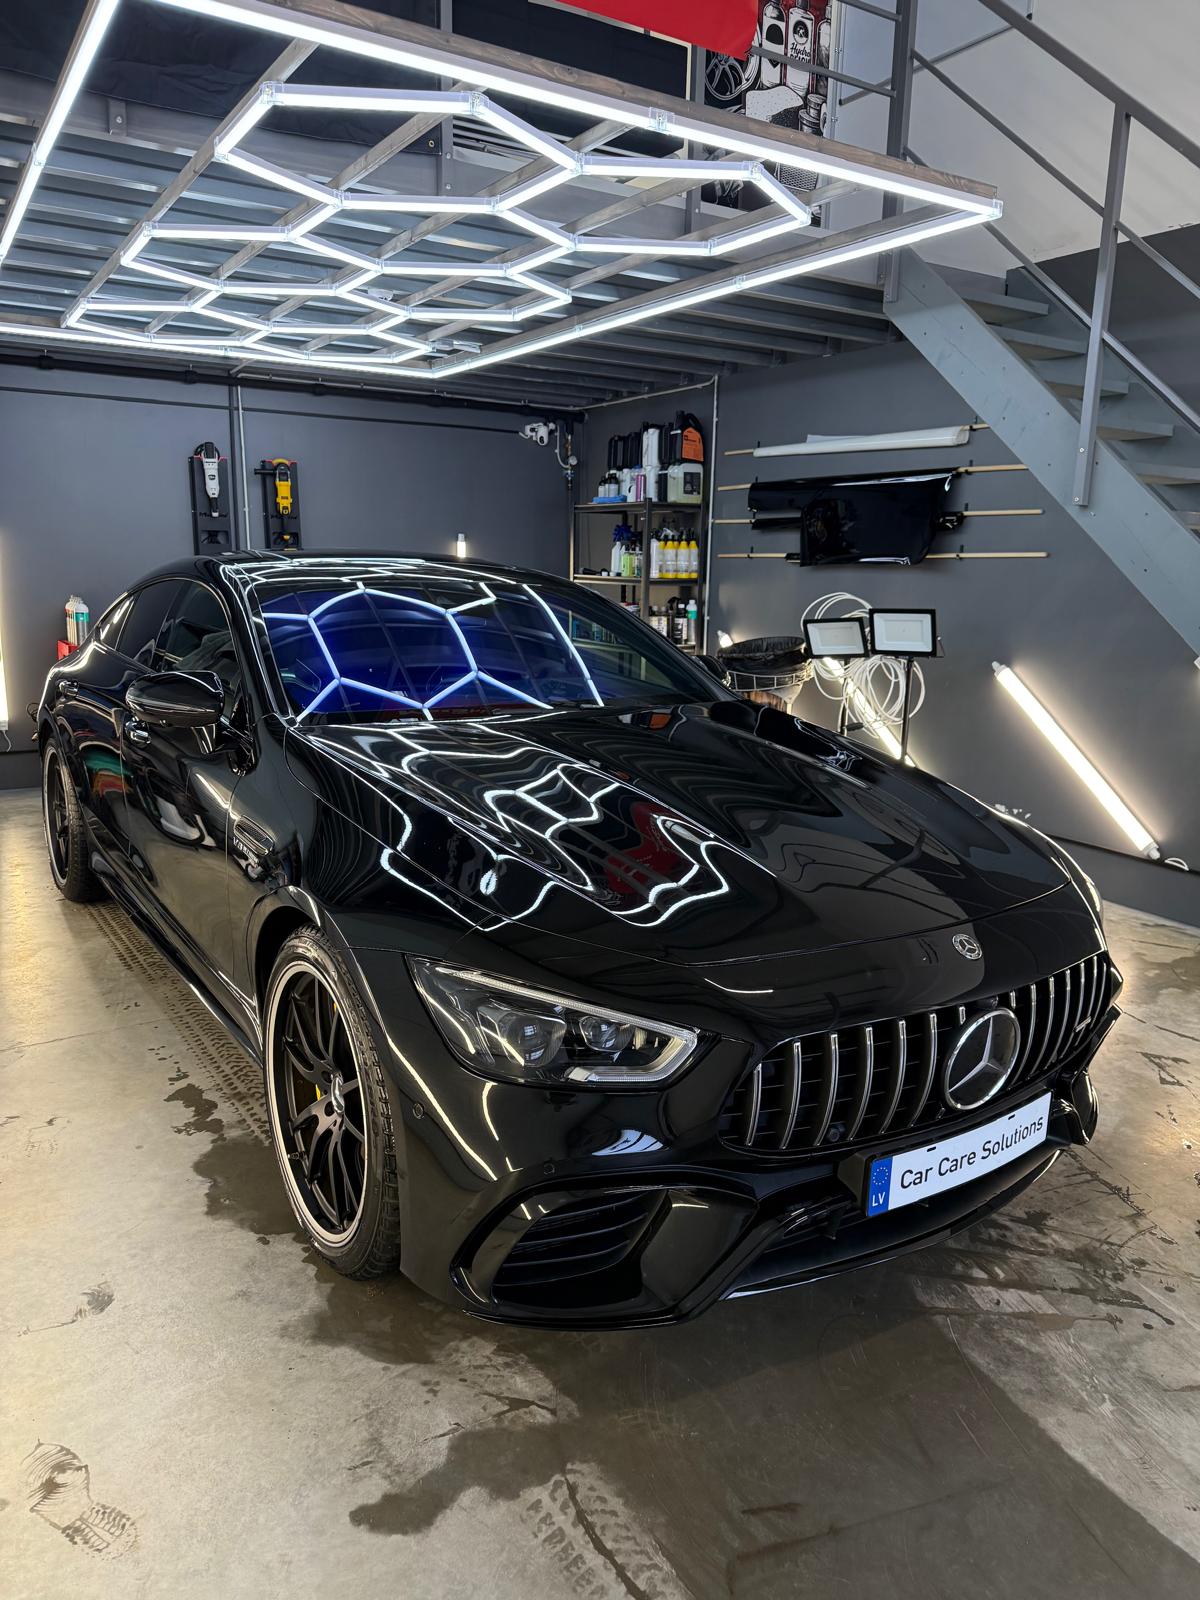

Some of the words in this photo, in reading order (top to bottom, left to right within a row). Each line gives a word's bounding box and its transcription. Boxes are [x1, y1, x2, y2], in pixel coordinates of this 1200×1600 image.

[900, 1167, 934, 1189] Car
[938, 1151, 976, 1176] Care
[981, 1116, 1043, 1159] Solutions
[872, 1192, 886, 1207] LV
